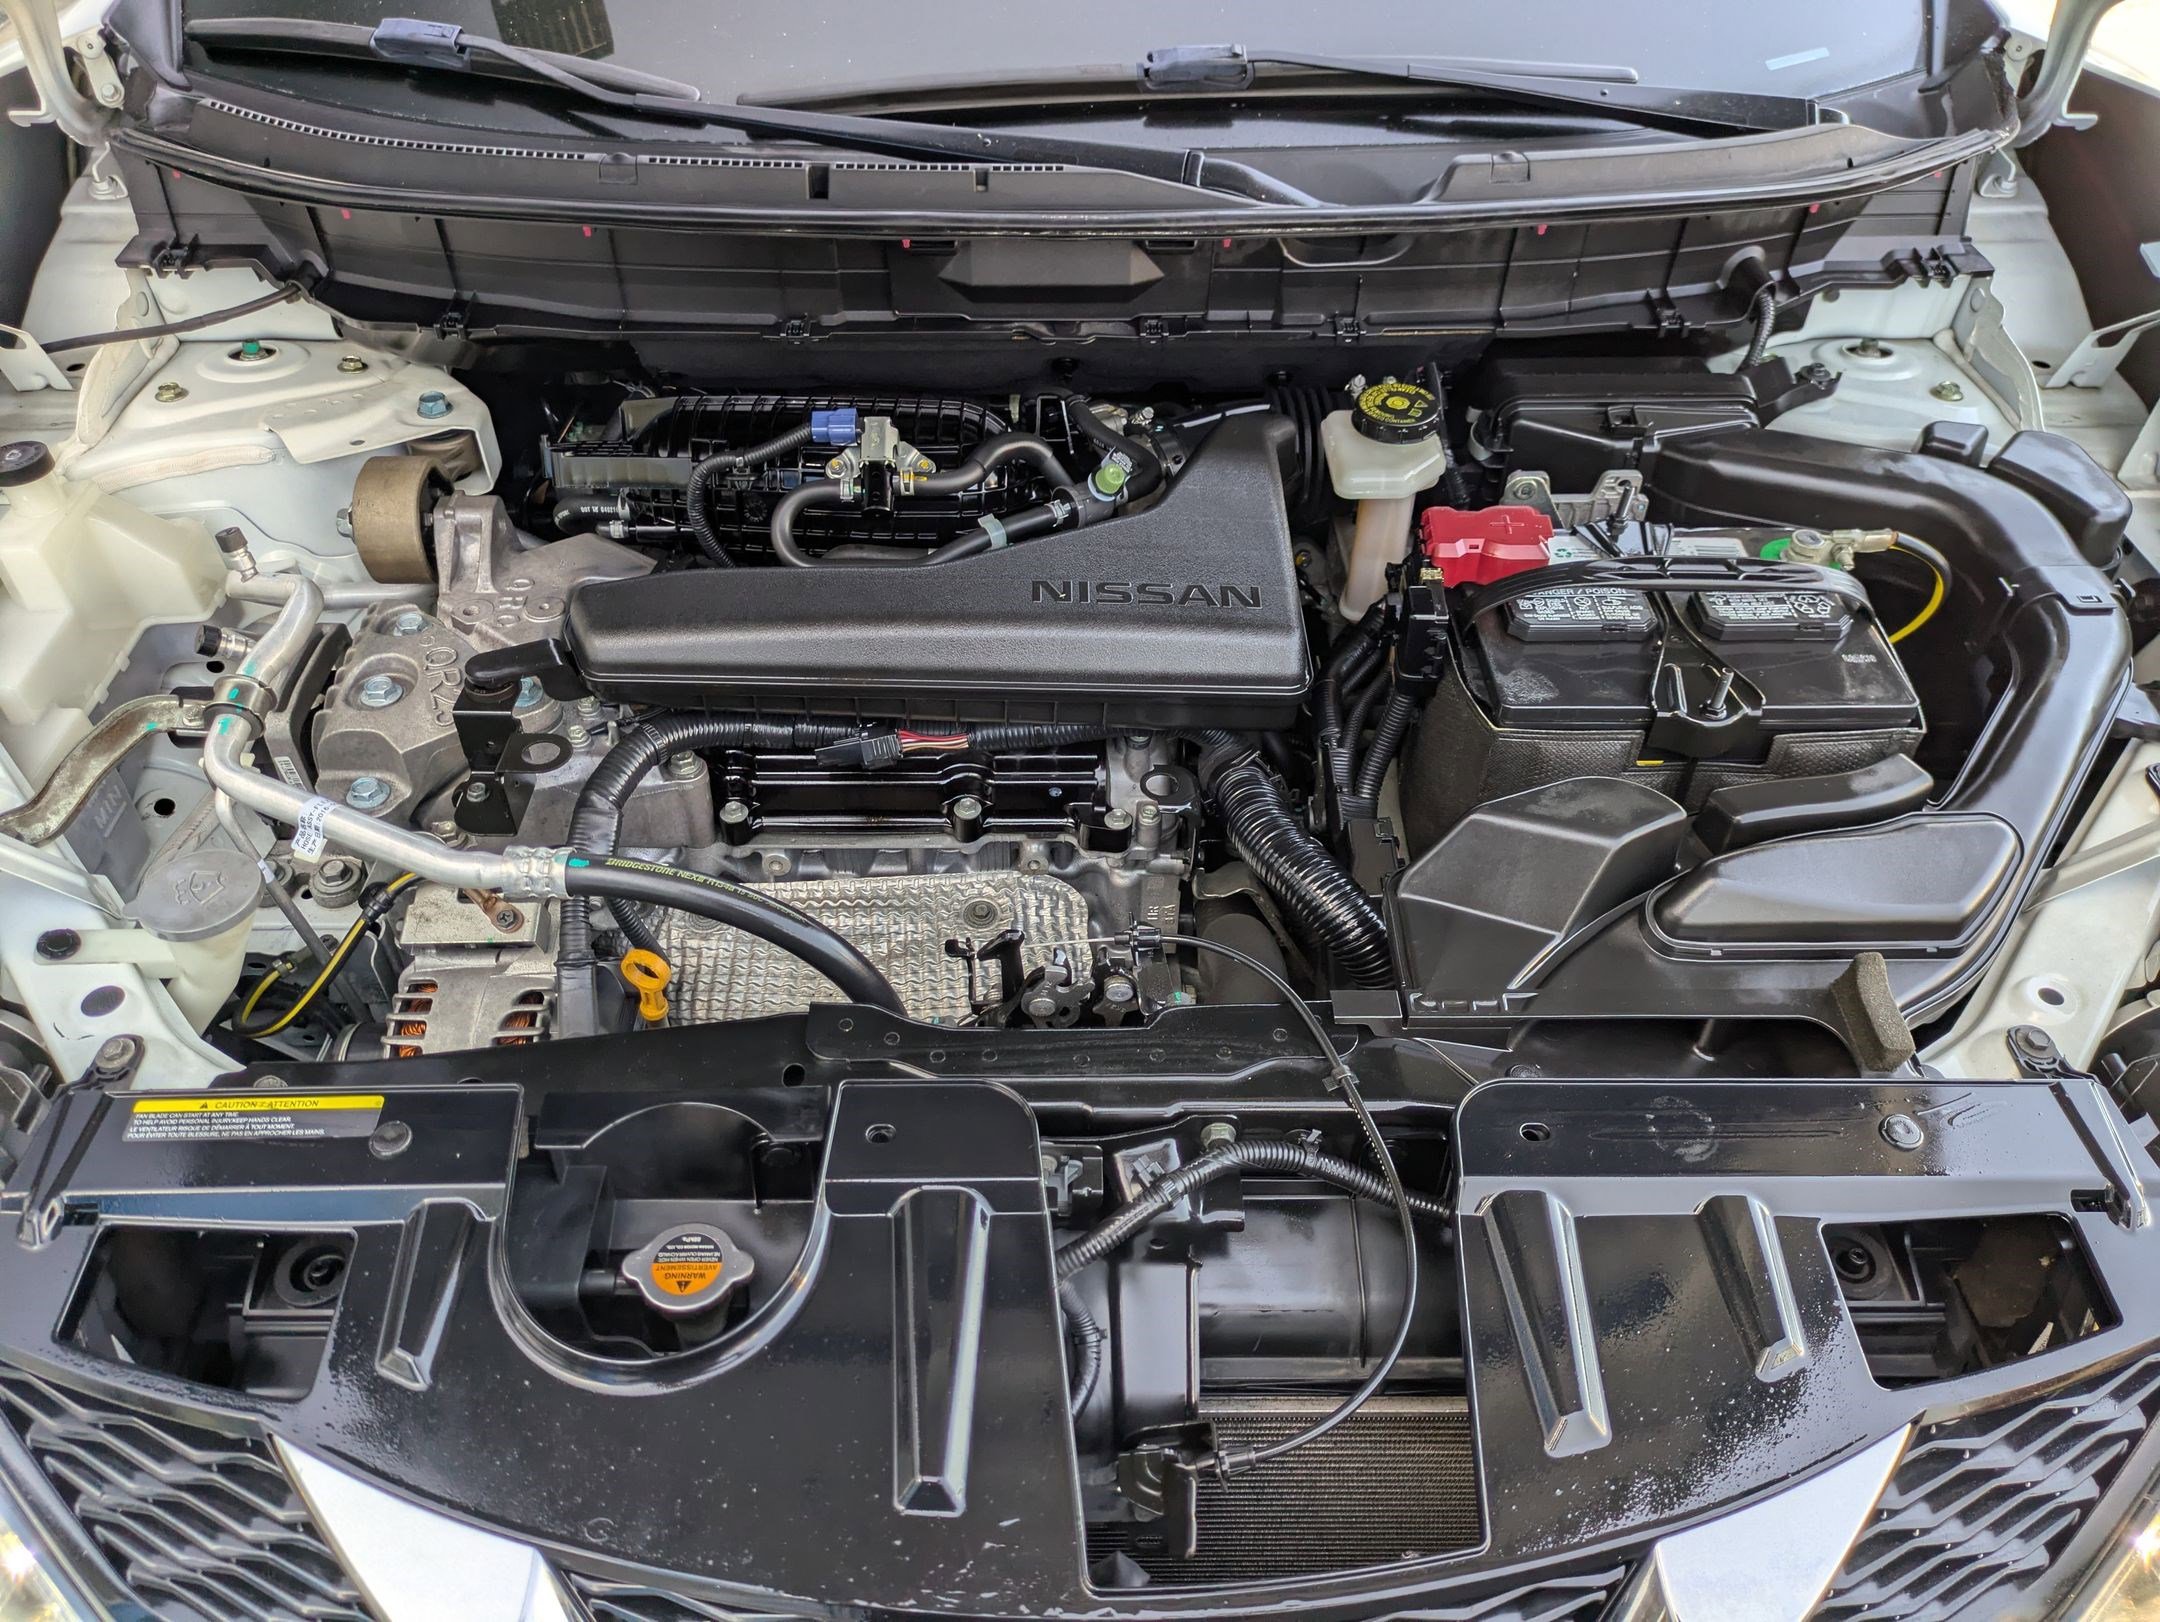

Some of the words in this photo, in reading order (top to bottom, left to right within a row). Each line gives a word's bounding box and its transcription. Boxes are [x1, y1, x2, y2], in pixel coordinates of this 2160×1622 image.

[1032, 580, 1263, 609] NISSAN
[94, 785, 123, 829] MIN
[301, 832, 313, 850] HOSE
[605, 857, 676, 876] BRIDGESTONE
[215, 1101, 257, 1109] CAUTION
[269, 1100, 320, 1108] ATTENTION
[664, 1272, 706, 1280] WARNING
